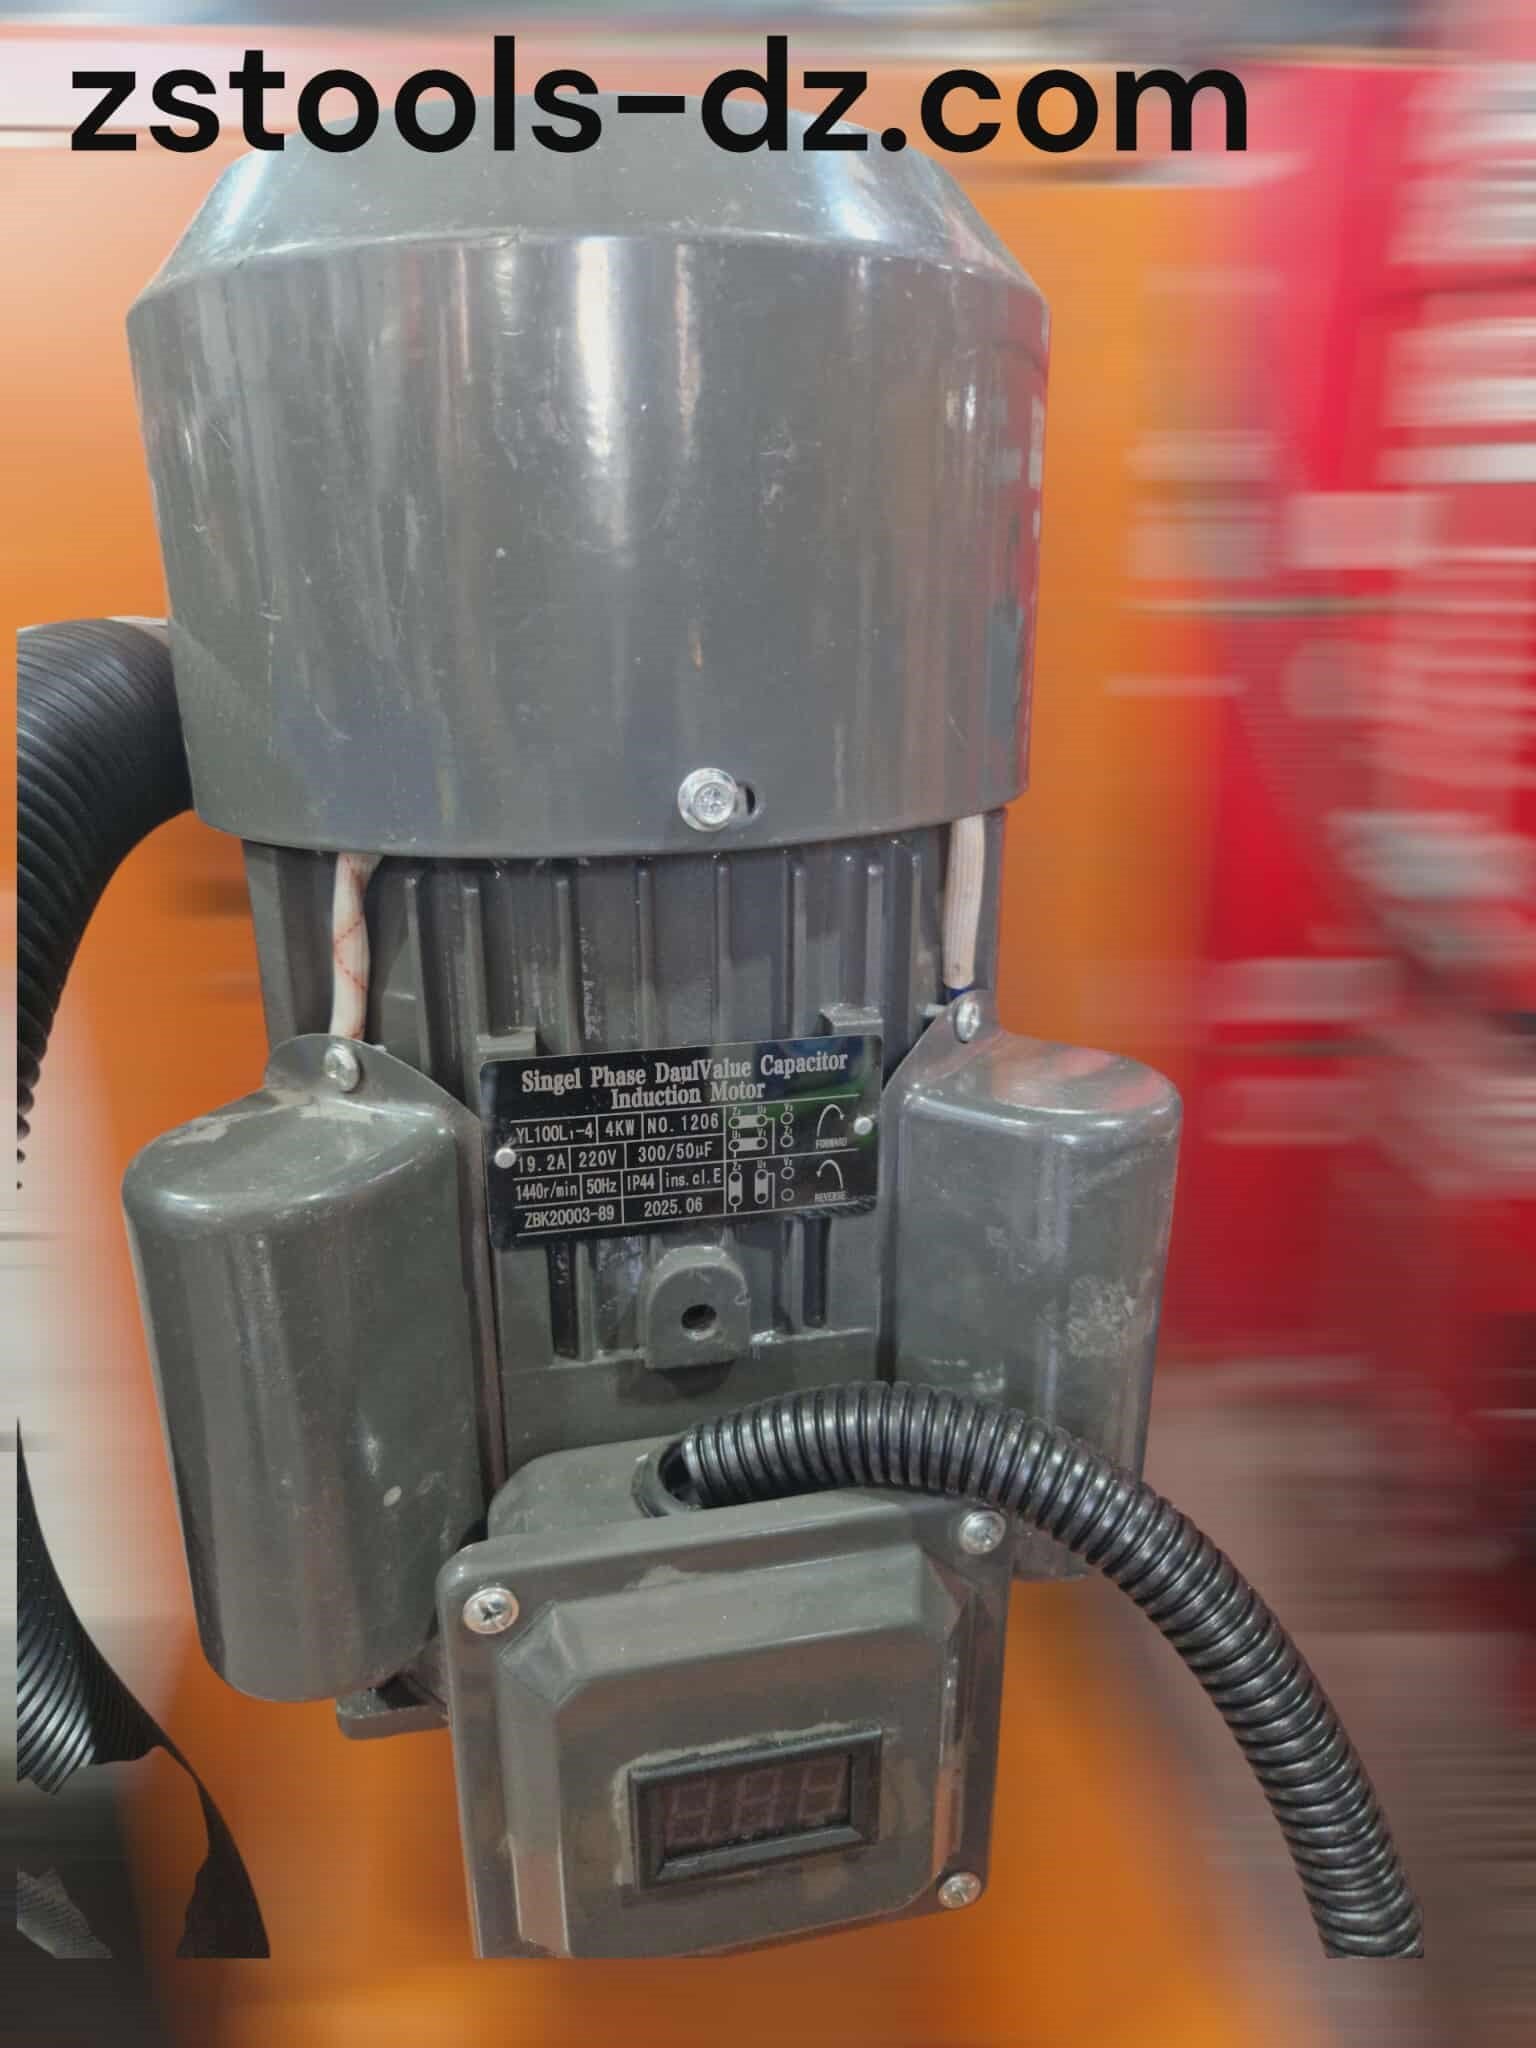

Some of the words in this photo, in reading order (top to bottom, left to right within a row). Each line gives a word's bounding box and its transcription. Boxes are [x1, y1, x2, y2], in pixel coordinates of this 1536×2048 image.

[521, 1067, 583, 1096] Singel
[590, 1064, 647, 1089] Phase
[760, 1050, 849, 1080] Capacitor
[610, 1084, 702, 1110] Induction
[710, 1080, 766, 1103] Motor
[605, 1118, 635, 1137] 4KW
[518, 1152, 567, 1174] 19.2A
[578, 1148, 617, 1168] 220V
[515, 1180, 578, 1201] 1440r/min
[586, 1176, 618, 1195] 50Hz
[626, 1172, 655, 1192] IP44
[524, 1204, 615, 1229] ZBK20003-89
[643, 1196, 703, 1218] 2025.06
